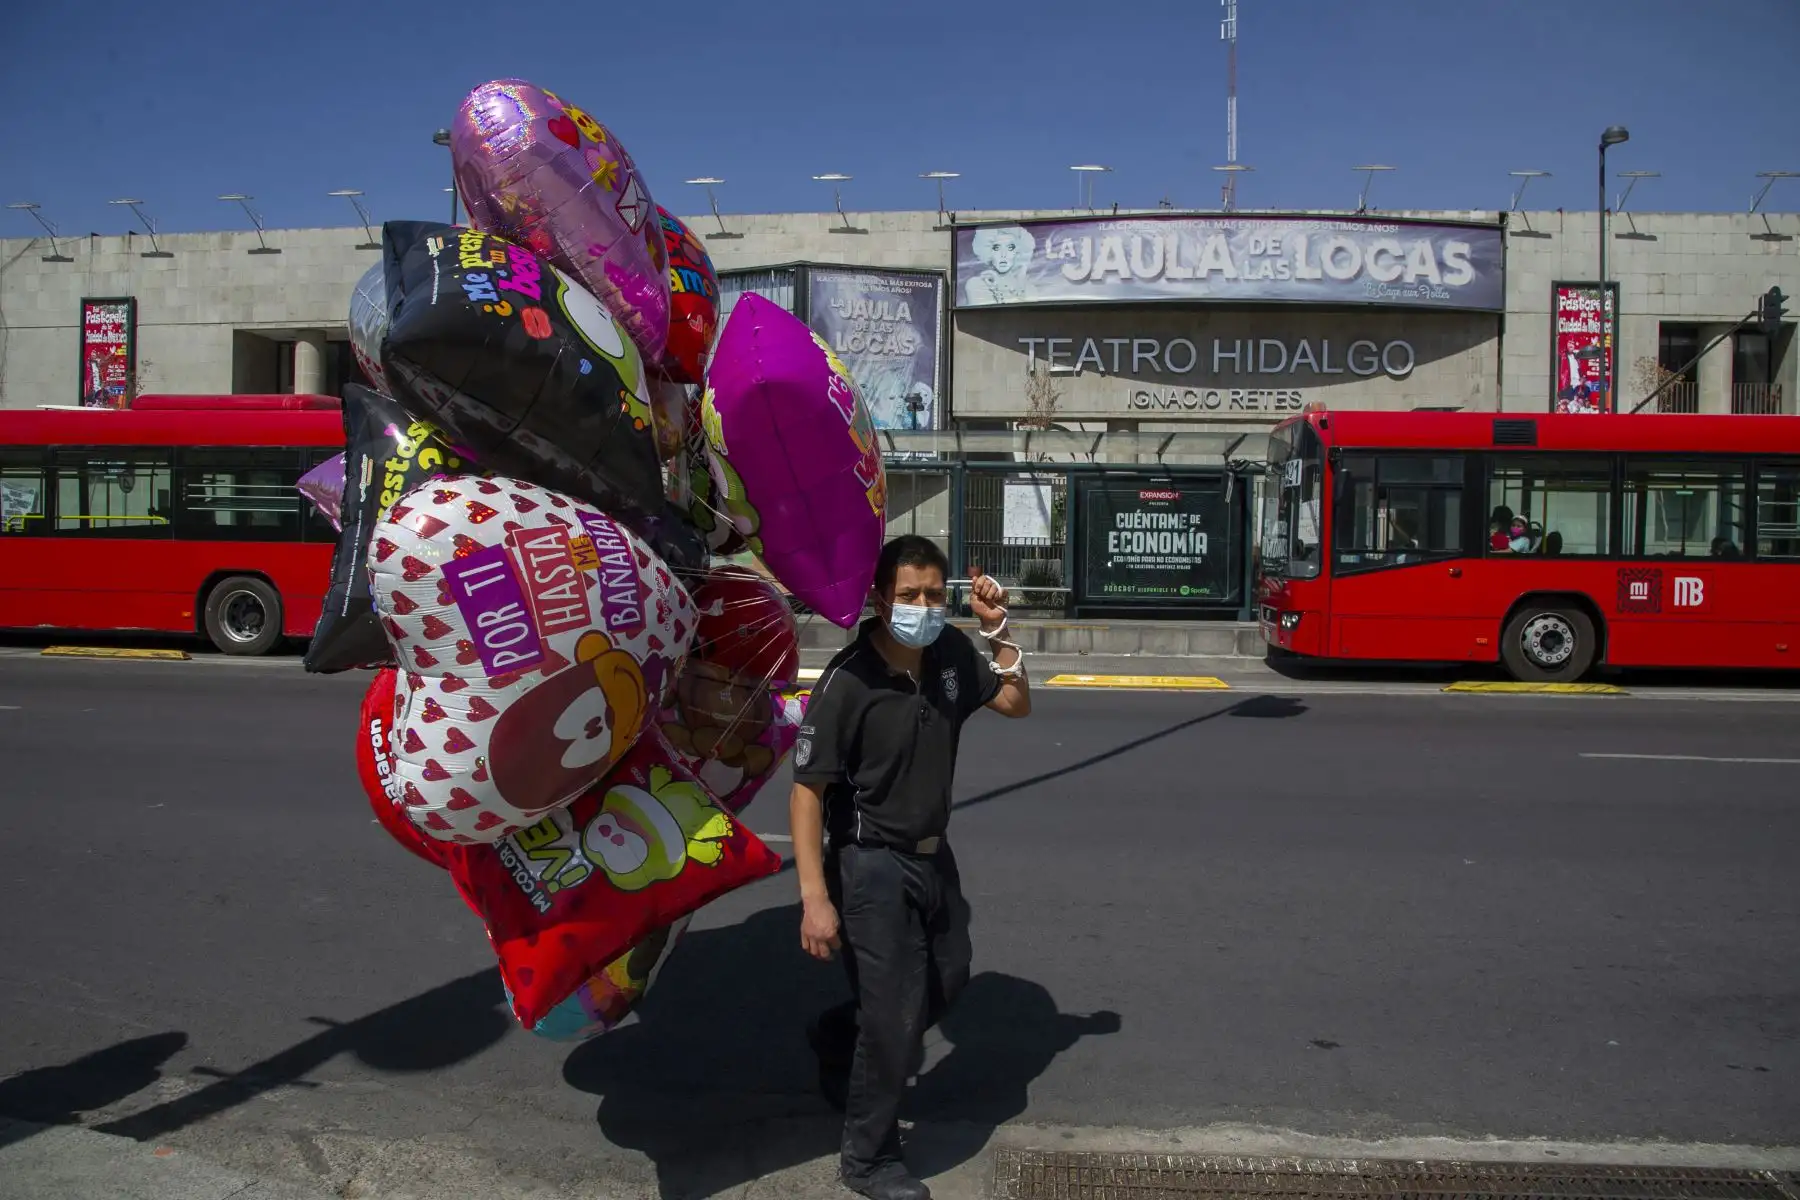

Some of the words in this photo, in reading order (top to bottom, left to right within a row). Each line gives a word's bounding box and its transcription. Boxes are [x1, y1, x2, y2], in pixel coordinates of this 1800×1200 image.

[1045, 237, 1077, 259] LA
[1061, 232, 1240, 283] JAULA
[1248, 236, 1282, 256] DE
[1294, 234, 1475, 287] LOCAS
[1242, 259, 1291, 281] LAS
[831, 297, 845, 308] LA
[839, 298, 913, 323] JAULA
[855, 322, 869, 332] DE
[873, 322, 894, 333] LAS
[836, 331, 919, 356] LOCAS
[1018, 337, 1198, 376] TEATRO
[1212, 338, 1415, 378] HIDALGO
[1127, 388, 1221, 409] IGNACIO
[1229, 388, 1303, 409] RETES
[1116, 509, 1188, 529] CUÉNTAME
[1189, 514, 1201, 524] DE
[569, 536, 598, 567] ME
[1108, 528, 1208, 554] ECONOMÍA
[458, 560, 506, 597] TI
[524, 531, 587, 627] HASTA
[586, 518, 641, 627] BAÑARÍA
[1673, 576, 1704, 606] MB
[476, 602, 540, 669] POR
[500, 845, 535, 894] COLOR
[531, 891, 552, 913] MI
